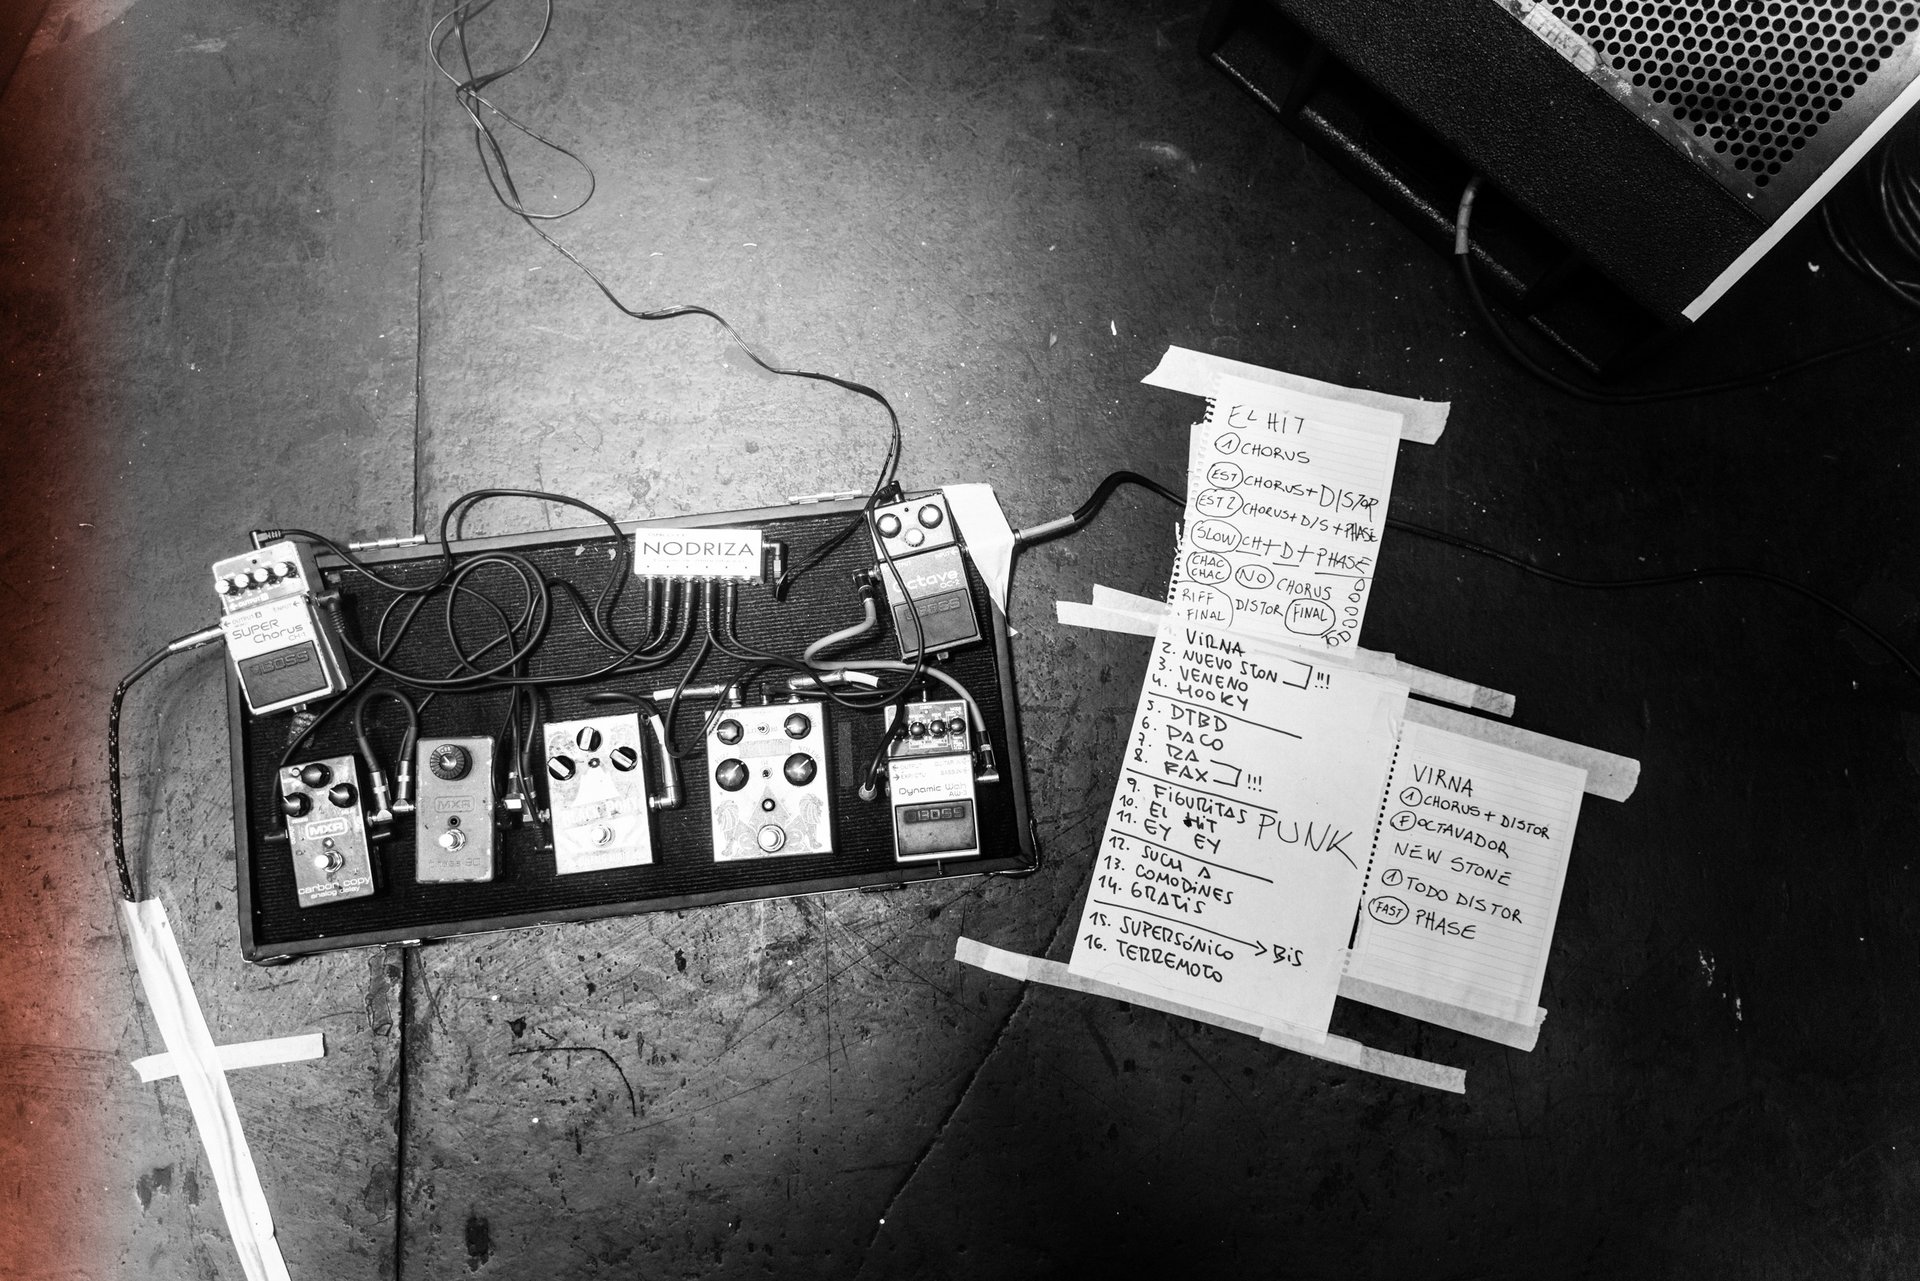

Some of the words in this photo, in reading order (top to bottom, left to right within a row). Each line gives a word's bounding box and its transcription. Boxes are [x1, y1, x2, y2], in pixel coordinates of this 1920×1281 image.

[1228, 404, 1257, 428] EL
[1268, 412, 1304, 434] HIT
[1241, 442, 1310, 463] CHORUS
[1211, 469, 1238, 481] EST
[1197, 526, 1236, 546] SLOW
[643, 541, 754, 556] NODRIZA
[1192, 555, 1225, 568] CHAC
[940, 578, 961, 589] OC-2
[1191, 568, 1225, 580] CHAC
[1239, 569, 1267, 583] NO
[1276, 578, 1333, 601] CHORUS
[1182, 588, 1214, 605] RIFF
[1187, 607, 1226, 620] FINAL
[1235, 598, 1283, 617] DISTOR
[1293, 603, 1327, 623] FINAL
[232, 618, 280, 640] SUPER
[253, 624, 304, 644] Chorus
[261, 650, 310, 675] BOSS
[1162, 641, 1176, 655] 2.
[1183, 650, 1233, 670] NUEVO
[1240, 661, 1277, 683] STON
[1158, 656, 1173, 672] 3.
[1180, 665, 1249, 692] VENENO
[1152, 673, 1168, 688] 4.
[1177, 681, 1249, 711] HOOKY
[1142, 716, 1157, 731] 6.
[1147, 699, 1161, 713] 5.
[1171, 703, 1228, 732] DTBD
[1138, 732, 1152, 748] 7.
[1134, 748, 1148, 763] 8.
[1164, 761, 1208, 782] FAX
[898, 785, 941, 797] Dynamic
[944, 783, 967, 792] Wah
[1127, 777, 1140, 793] 9.
[1413, 764, 1473, 797] VIRNA
[437, 800, 471, 810] MXR
[1119, 794, 1138, 808] 10.
[917, 808, 964, 821] BOSS
[1423, 796, 1481, 816] CHORUS
[1500, 815, 1550, 839] DISTOR
[309, 820, 344, 837] MXR
[1116, 810, 1137, 823] 11.
[1144, 818, 1171, 842] EY
[1194, 833, 1221, 854] EY
[1417, 818, 1509, 859] OCTAVADOR
[1108, 836, 1130, 851] 12.
[1258, 813, 1358, 870] PUNK
[1104, 855, 1125, 871] 13.
[1394, 842, 1442, 864] NEW
[1450, 857, 1512, 886] STONE
[298, 882, 340, 895] carbon
[343, 876, 371, 888] copy
[310, 890, 338, 900] analog
[1098, 875, 1122, 895] 14.
[1407, 876, 1448, 901] TODO
[1456, 892, 1522, 923] DISTOR
[1089, 911, 1111, 926] 15.
[1375, 901, 1404, 918] FAST
[1415, 909, 1476, 939] PHASE
[1084, 934, 1107, 951] 16.
[1116, 939, 1223, 983] TERREMOTO
